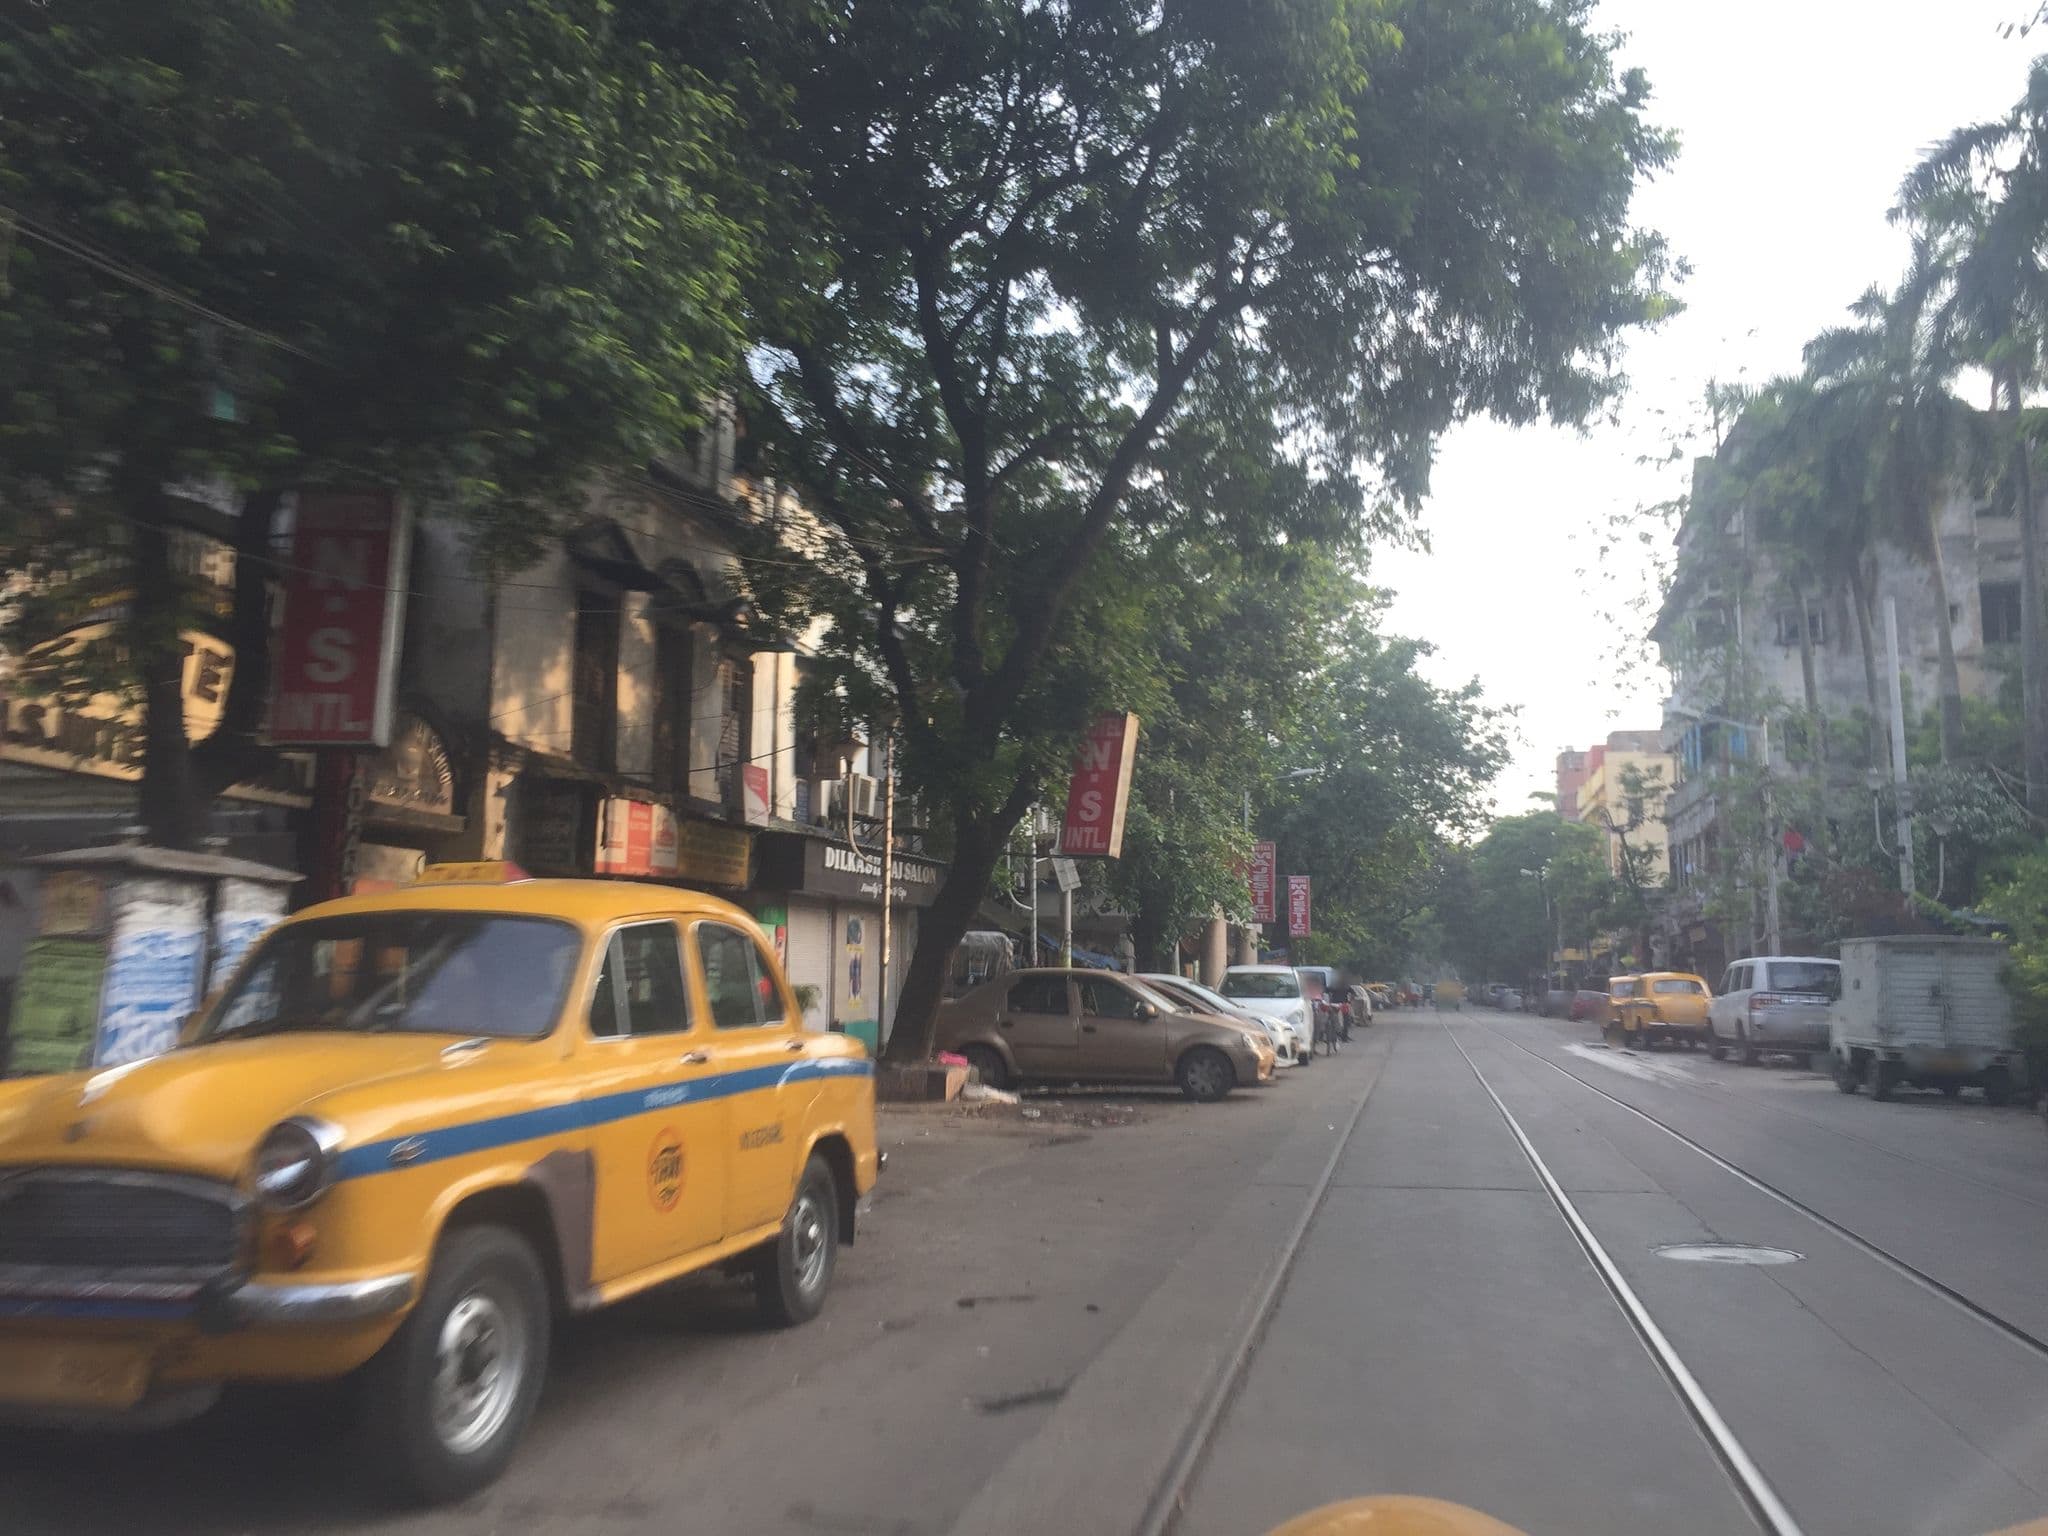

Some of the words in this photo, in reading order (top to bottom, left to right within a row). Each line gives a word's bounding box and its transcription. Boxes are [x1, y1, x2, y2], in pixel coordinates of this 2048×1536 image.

[824, 846, 882, 876] DILKASH
[902, 863, 937, 885] SALON
[1252, 852, 1272, 912] MAJESTIC
[1291, 884, 1307, 929] MAJESTIC
